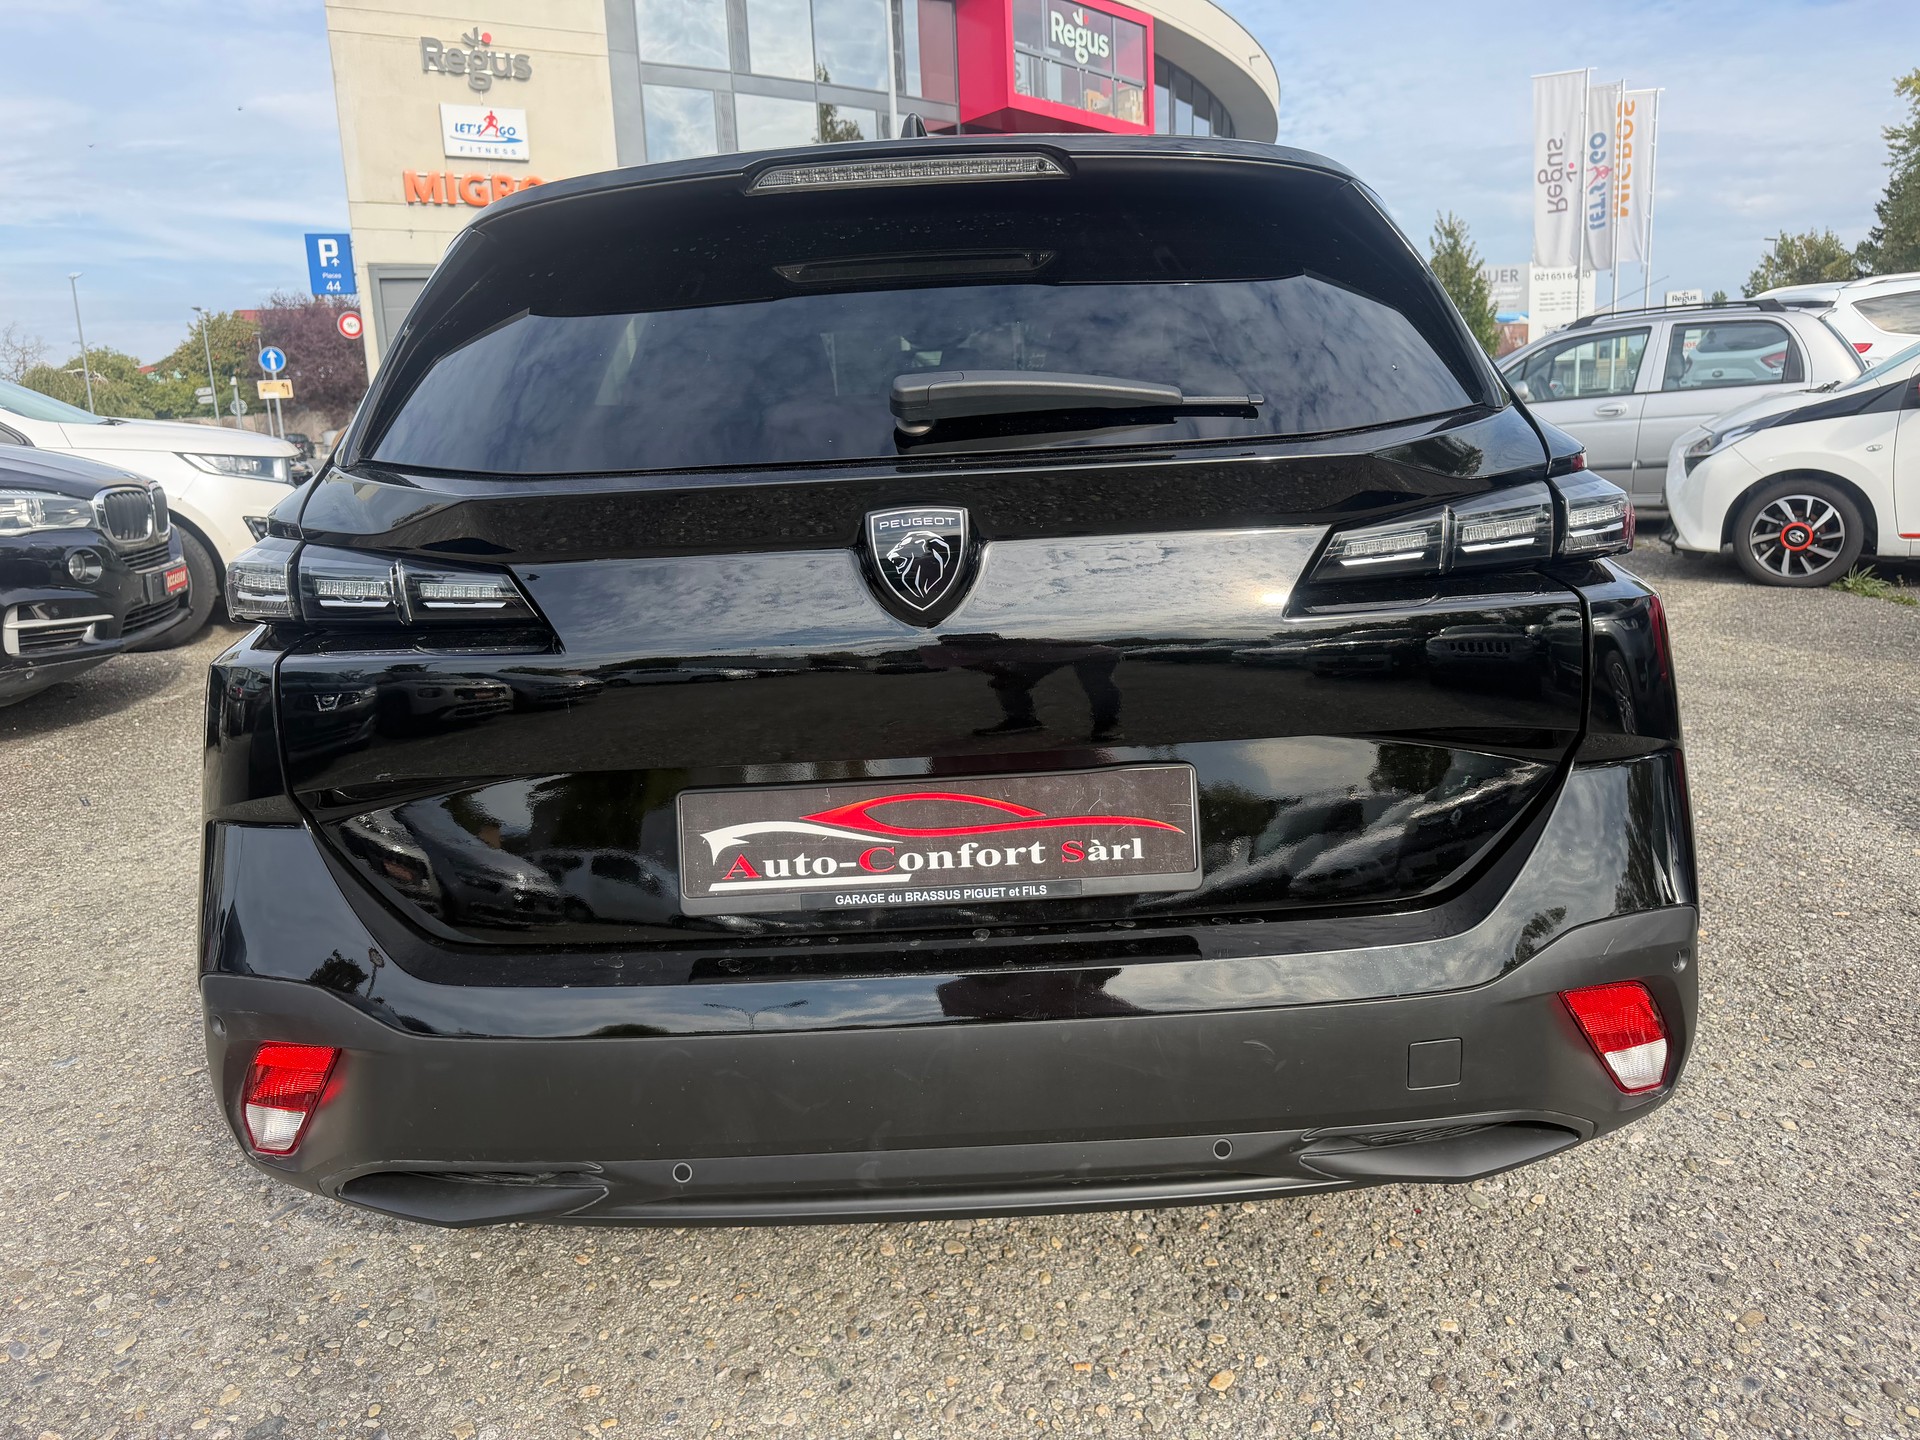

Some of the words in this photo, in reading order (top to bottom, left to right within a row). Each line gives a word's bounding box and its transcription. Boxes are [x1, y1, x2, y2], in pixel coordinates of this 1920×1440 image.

[1050, 10, 1110, 65] Regus
[420, 36, 532, 92] Regus
[454, 122, 482, 135] LET'S
[499, 126, 516, 136] GO
[459, 145, 517, 156] FITNESS
[403, 169, 562, 207] MIGR
[317, 238, 339, 268] P
[326, 280, 342, 292] 44
[879, 517, 956, 530] PEUGEOT
[722, 839, 1047, 881] Auto-Confort
[1060, 836, 1145, 864] Sàrl
[835, 893, 886, 905] GARAGE
[888, 893, 901, 903] du
[905, 889, 961, 902] BRASSUS
[963, 887, 1006, 900] PIGUET
[1008, 888, 1020, 897] et
[1022, 885, 1048, 897] FILS
